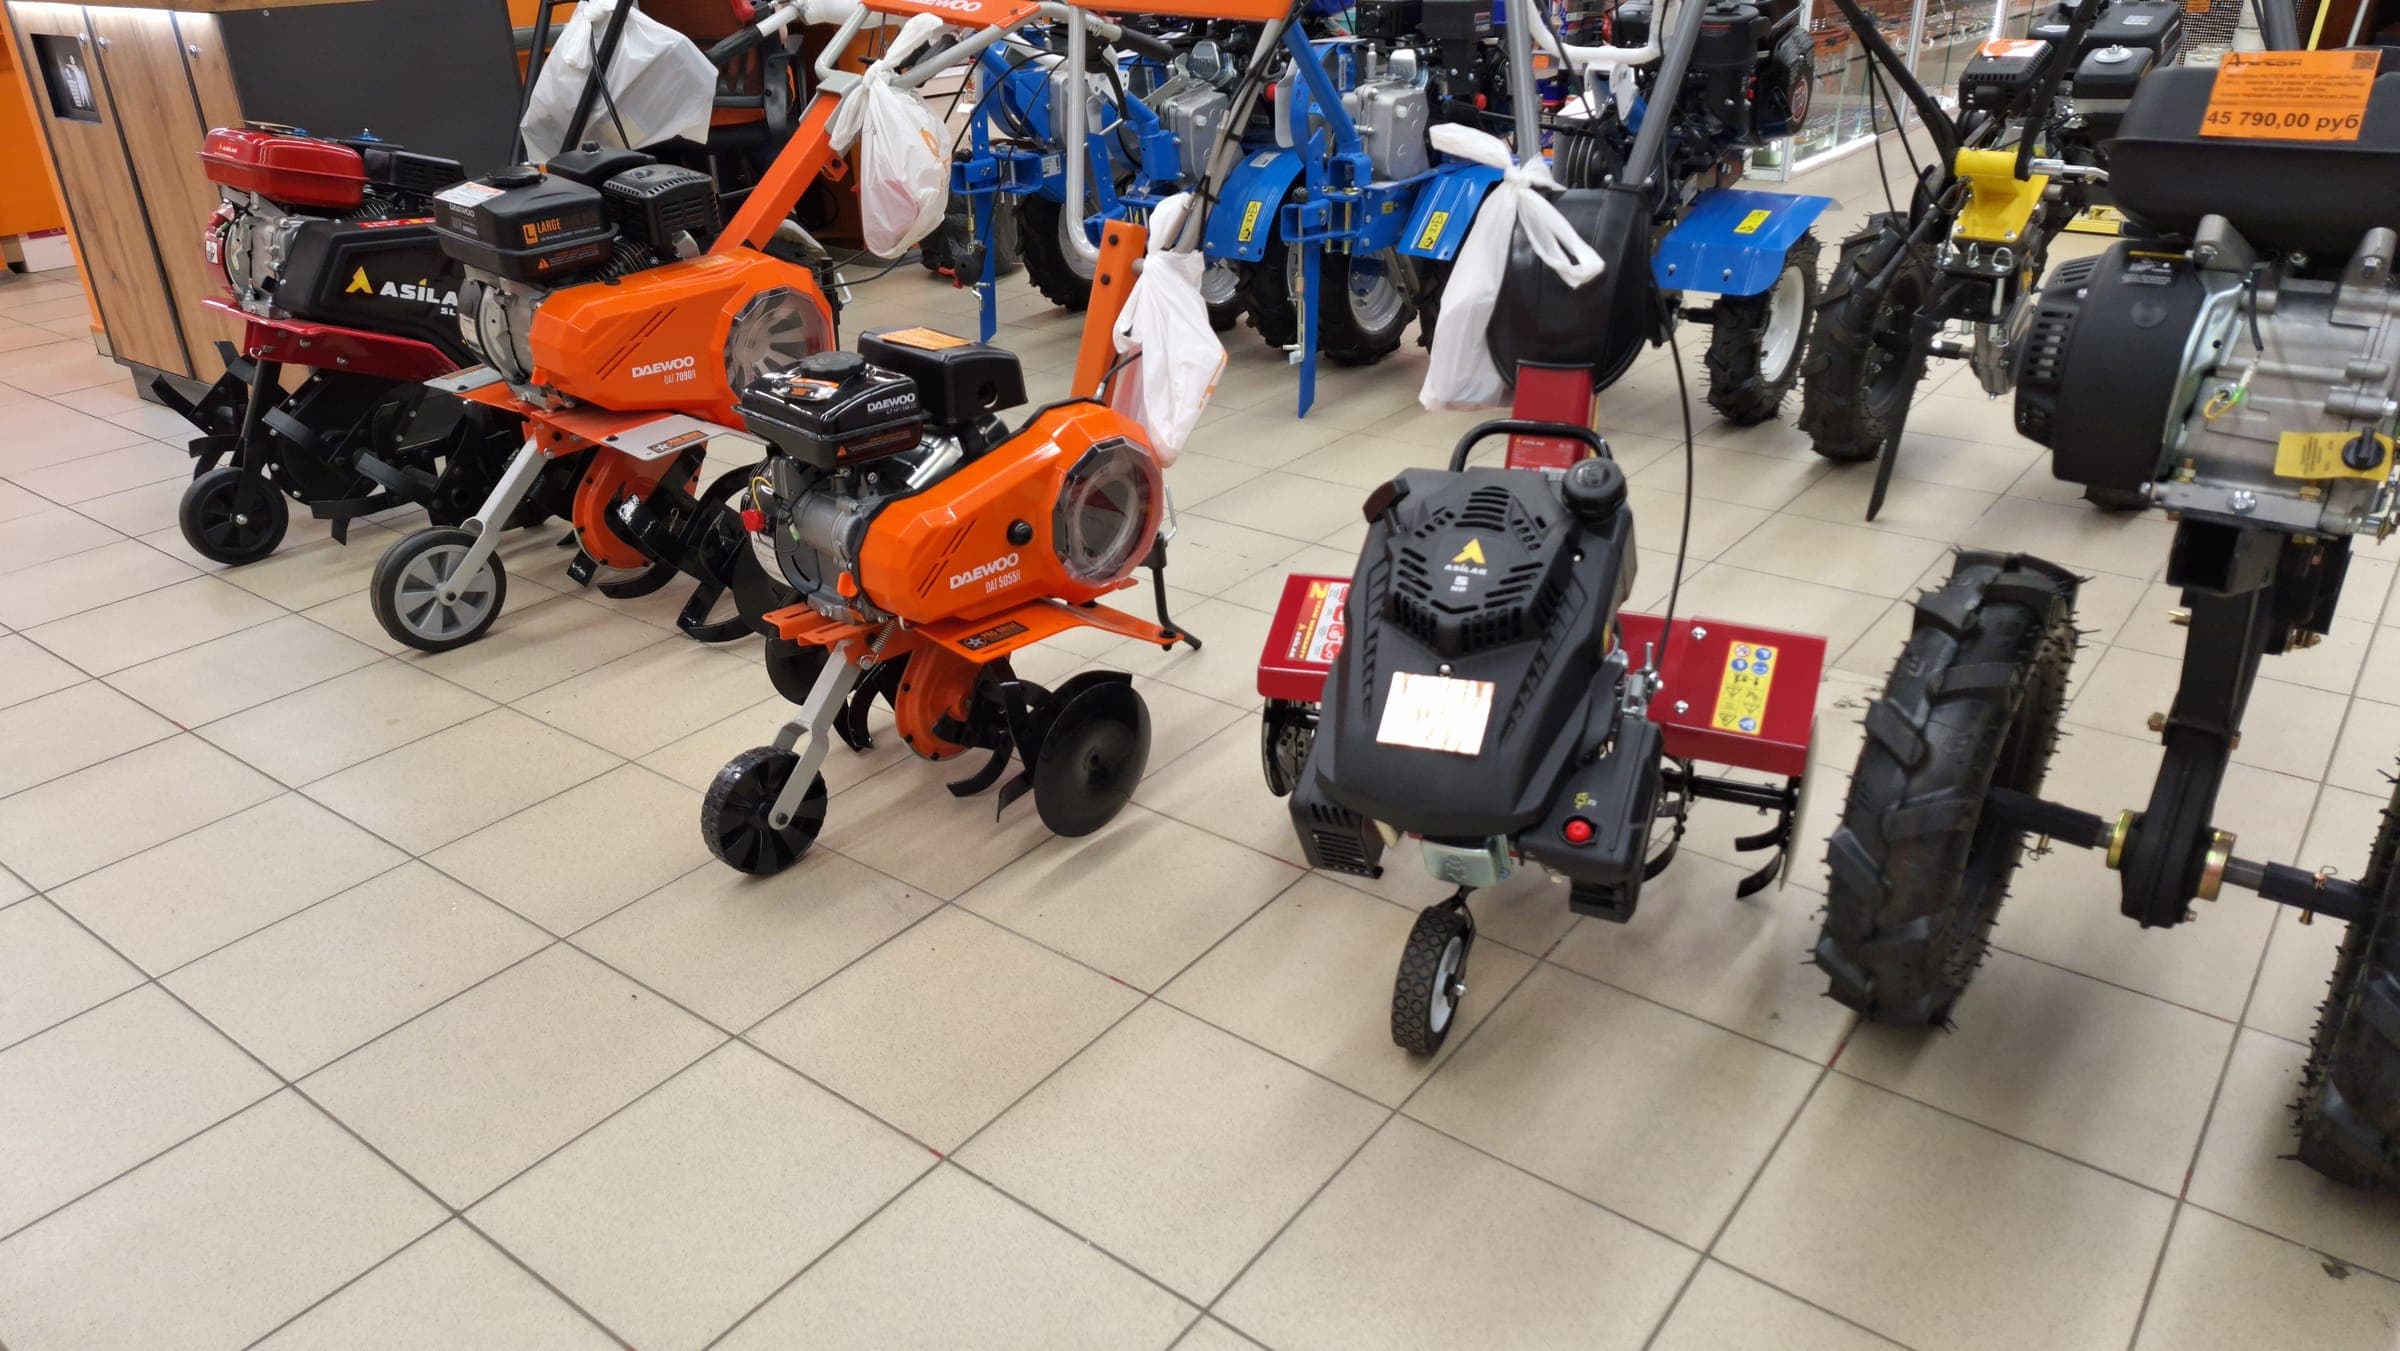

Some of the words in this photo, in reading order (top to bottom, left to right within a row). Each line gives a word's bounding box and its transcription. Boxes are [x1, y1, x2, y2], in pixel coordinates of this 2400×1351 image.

[2207, 111, 2232, 125] 45
[2240, 112, 2310, 130] 790,00
[2316, 114, 2361, 132] руб
[537, 218, 561, 234] LARGE
[380, 278, 458, 307] ASILA
[632, 356, 695, 378] DAEWOO
[867, 393, 916, 413] DAEWOO
[950, 553, 1020, 590] DAEWOO
[1454, 575, 1470, 586] 5
